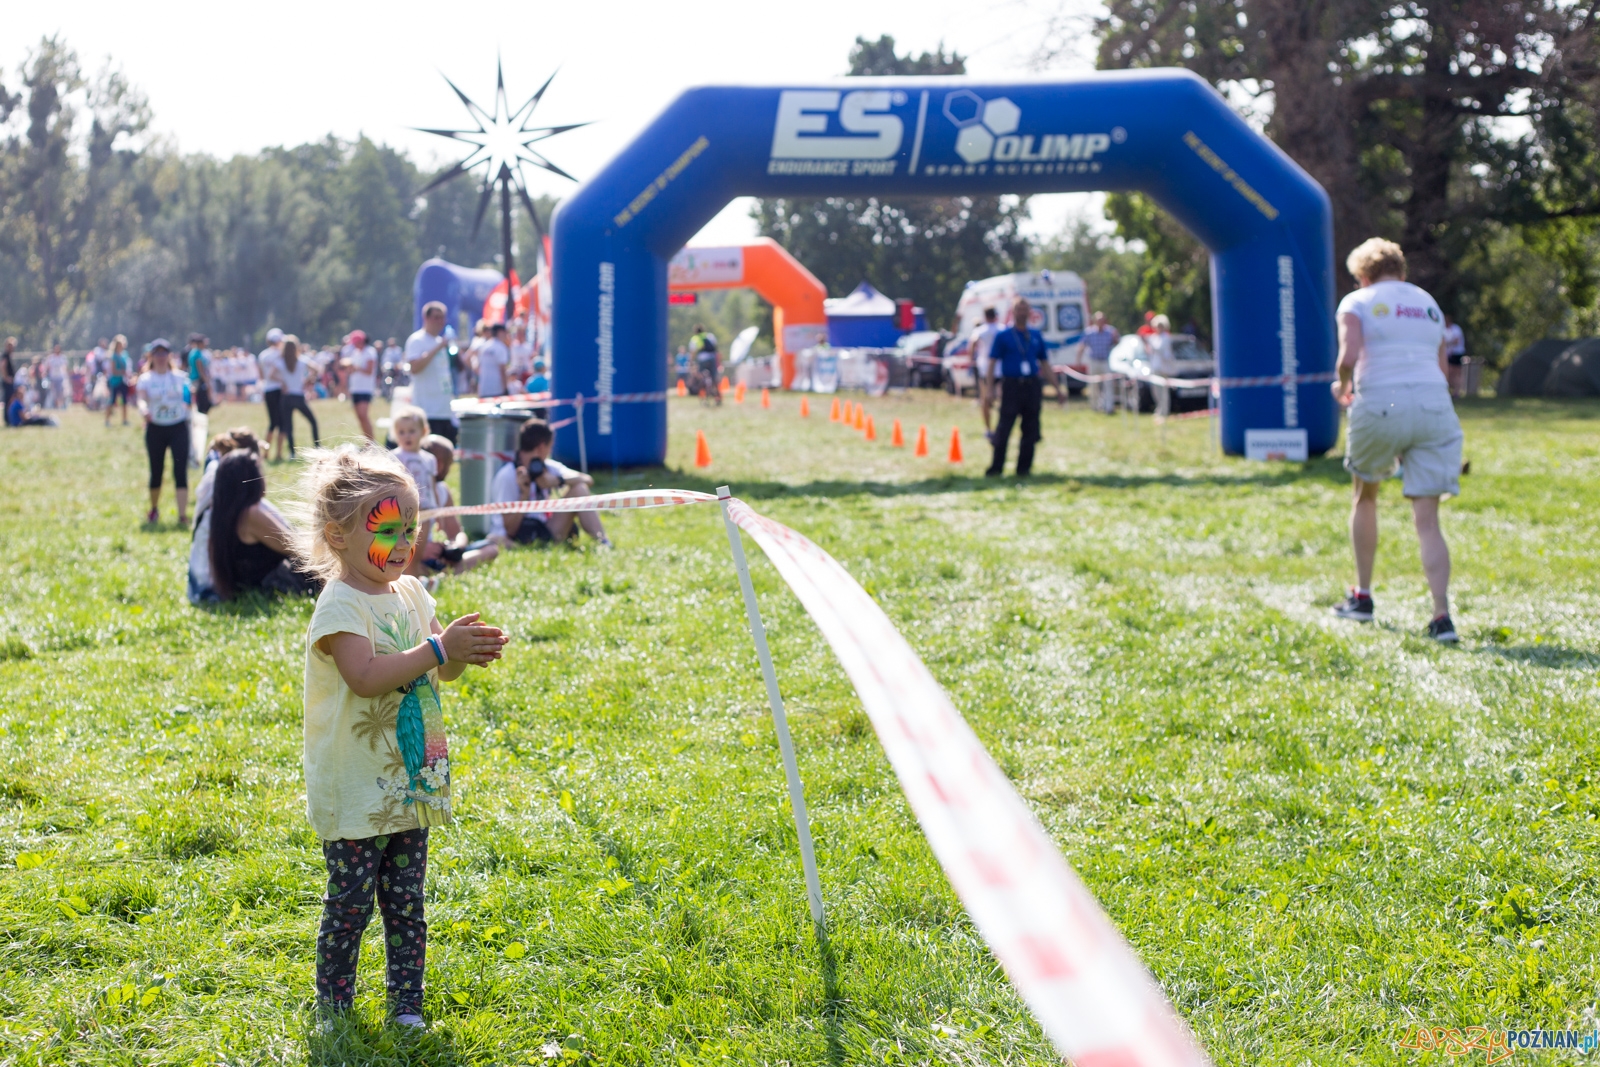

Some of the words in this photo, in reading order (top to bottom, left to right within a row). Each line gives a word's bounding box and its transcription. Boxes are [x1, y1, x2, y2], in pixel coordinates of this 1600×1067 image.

[768, 90, 904, 159] ES
[993, 134, 1111, 161] OLIMP
[767, 160, 848, 175] ENDURANCE
[852, 160, 898, 175] SPORT
[924, 165, 987, 176] SPORT
[994, 161, 1101, 174] NUTRITION
[597, 261, 616, 435] wwwolimpendurance.com
